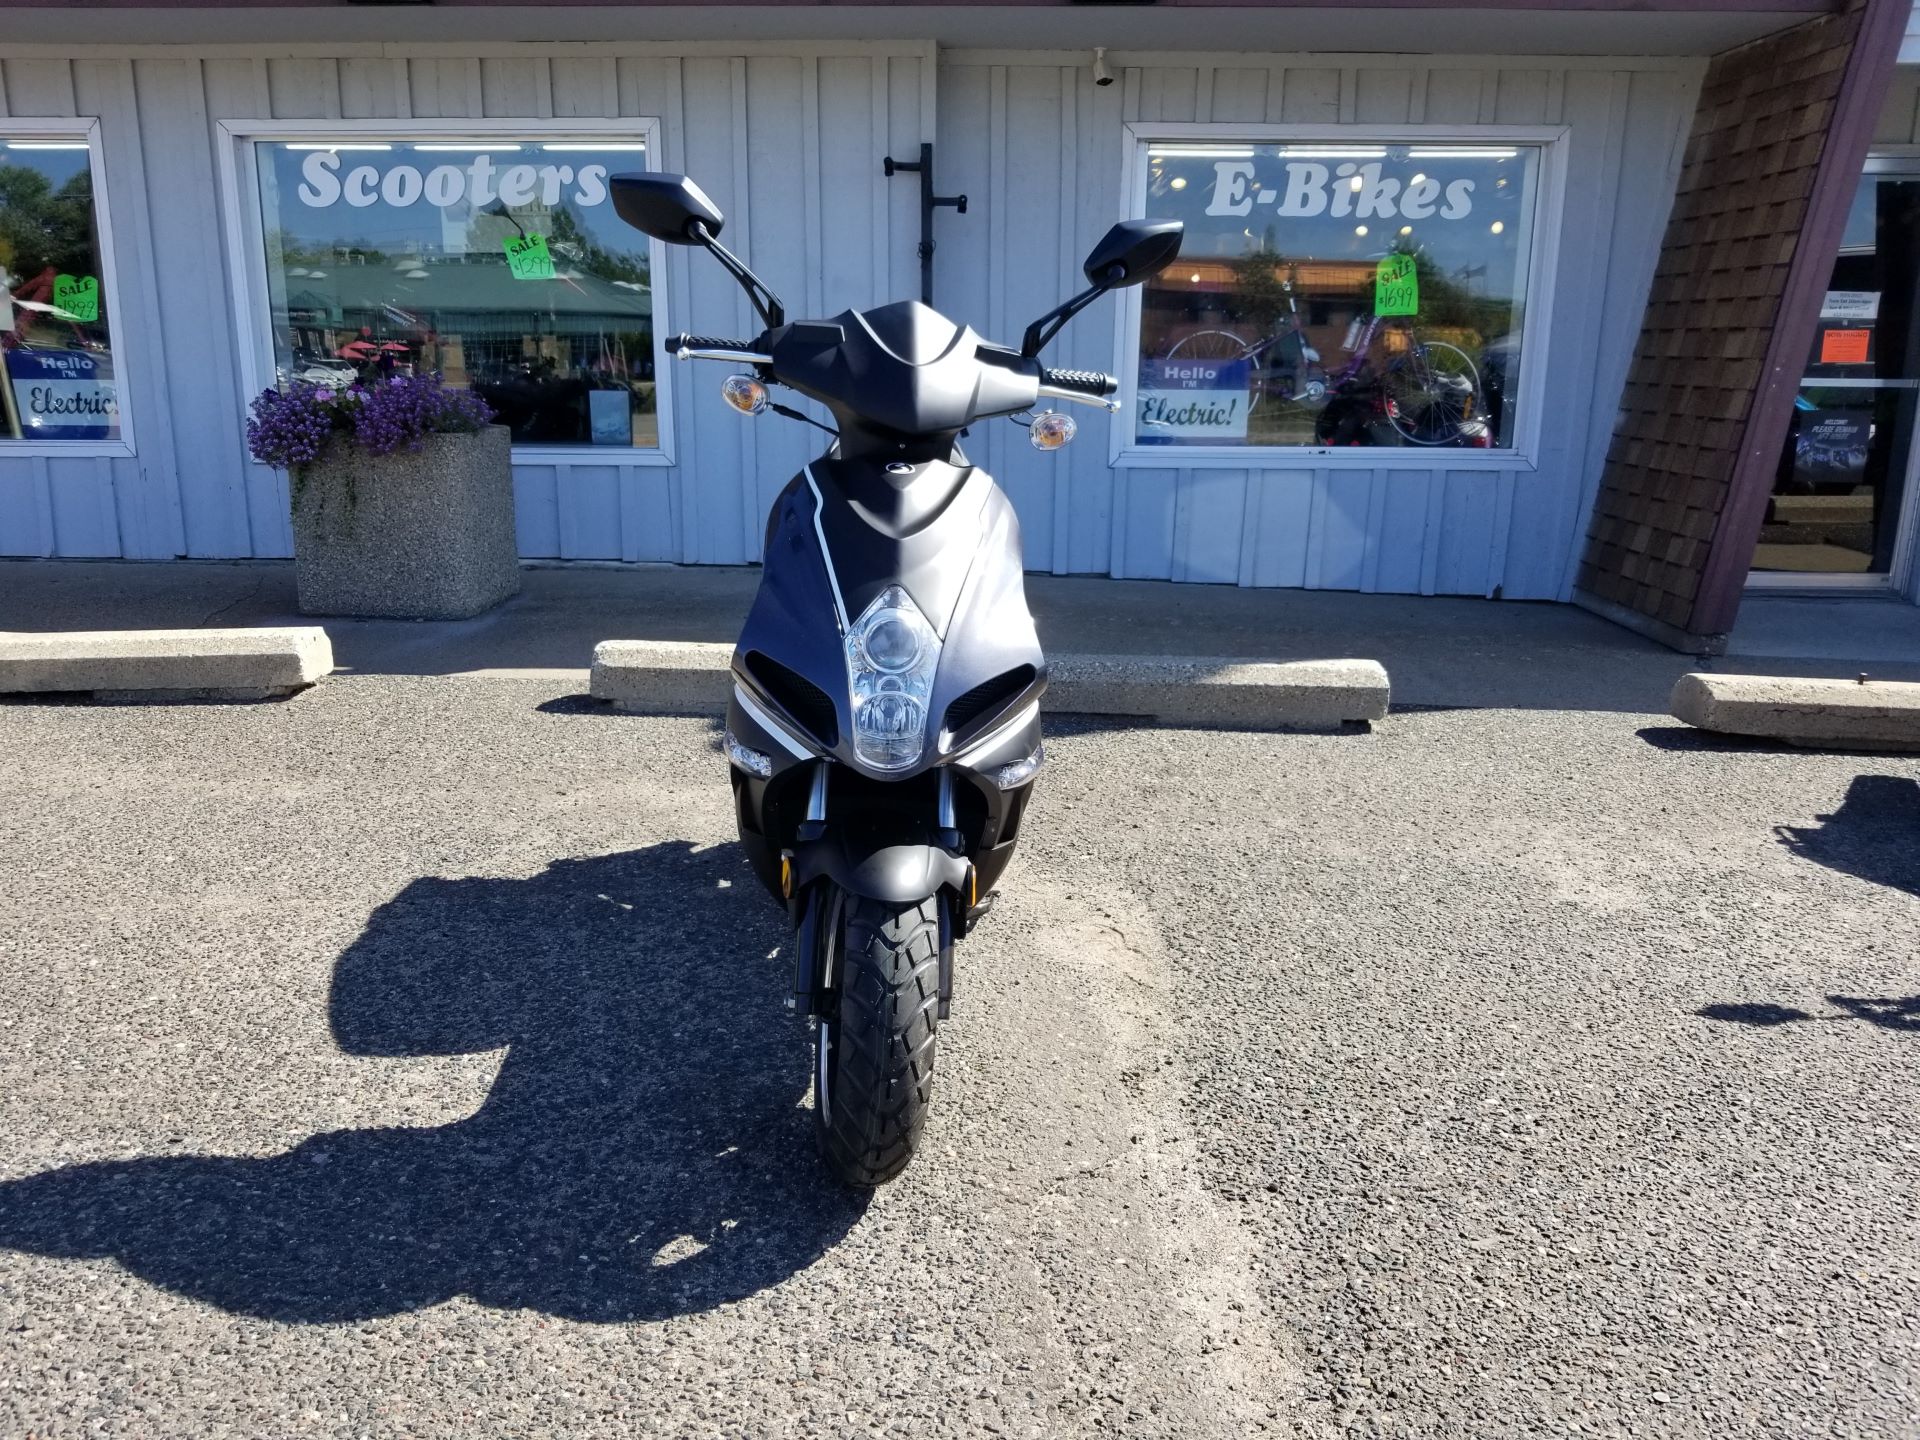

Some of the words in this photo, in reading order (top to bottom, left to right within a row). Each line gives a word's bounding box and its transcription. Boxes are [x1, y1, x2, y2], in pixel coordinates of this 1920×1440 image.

[298, 152, 607, 207] Scooters
[1205, 161, 1476, 219] E-Bikes
[510, 235, 540, 257] SALE
[1382, 260, 1413, 286] SALE
[59, 281, 92, 297] SALE
[41, 357, 94, 369] Hello
[1164, 366, 1216, 379] Hello
[1141, 397, 1237, 426] Electric!
